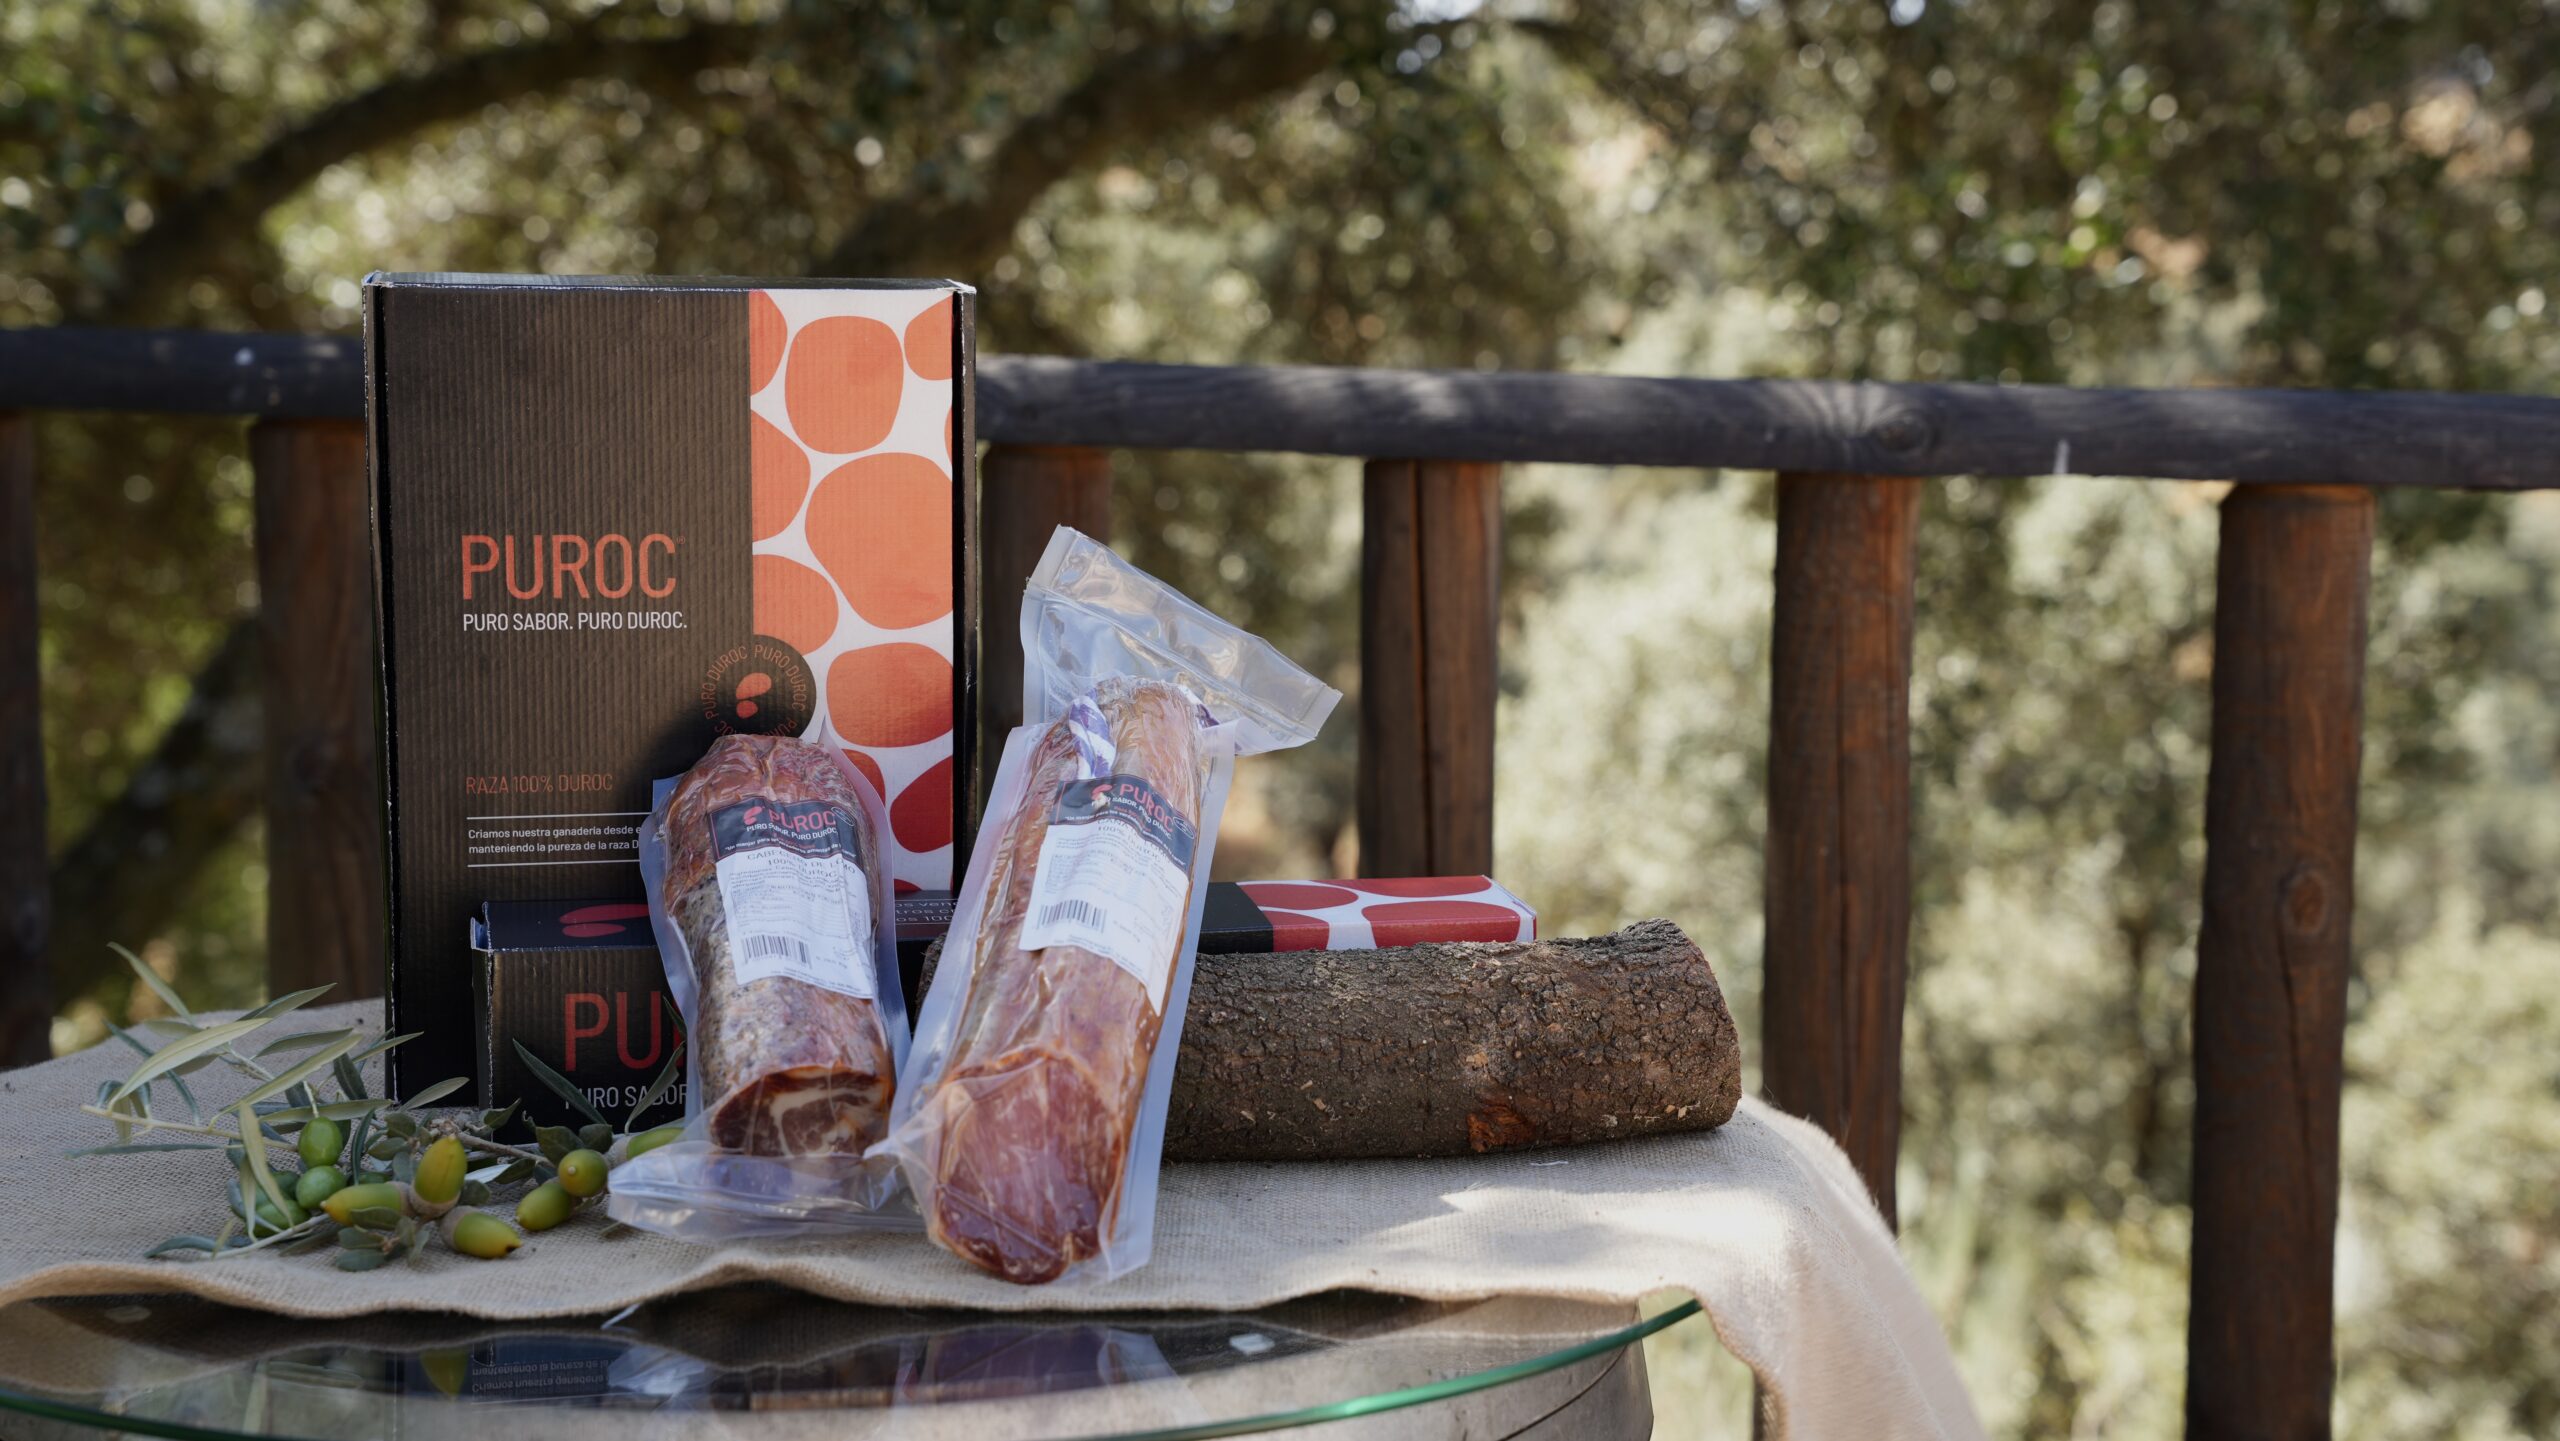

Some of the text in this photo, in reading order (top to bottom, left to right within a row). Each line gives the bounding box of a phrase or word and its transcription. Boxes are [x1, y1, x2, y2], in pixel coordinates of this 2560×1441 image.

[463, 611, 688, 631] PURO SABOR. PURO DUROC.
[707, 646, 748, 681] DUROC
[754, 644, 790, 669] PURO
[701, 682, 719, 720] PURO
[785, 665, 807, 712] DUROC
[466, 774, 613, 795] RAZA 100% DUROC
[1120, 783, 1174, 832] PUROC
[468, 829, 511, 839] Criamos
[512, 827, 551, 837] nuestra
[603, 825, 634, 835] desde
[746, 822, 768, 832] PURO
[791, 831, 812, 840] PURO
[768, 808, 836, 833] PUROC
[468, 843, 536, 855] manteniendo
[536, 843, 546, 852] la
[547, 842, 582, 853] pureza
[583, 840, 596, 850] de
[598, 840, 608, 850] la
[608, 841, 630, 849] raza
[564, 991, 686, 1072] PU
[565, 1086, 620, 1110] URO
